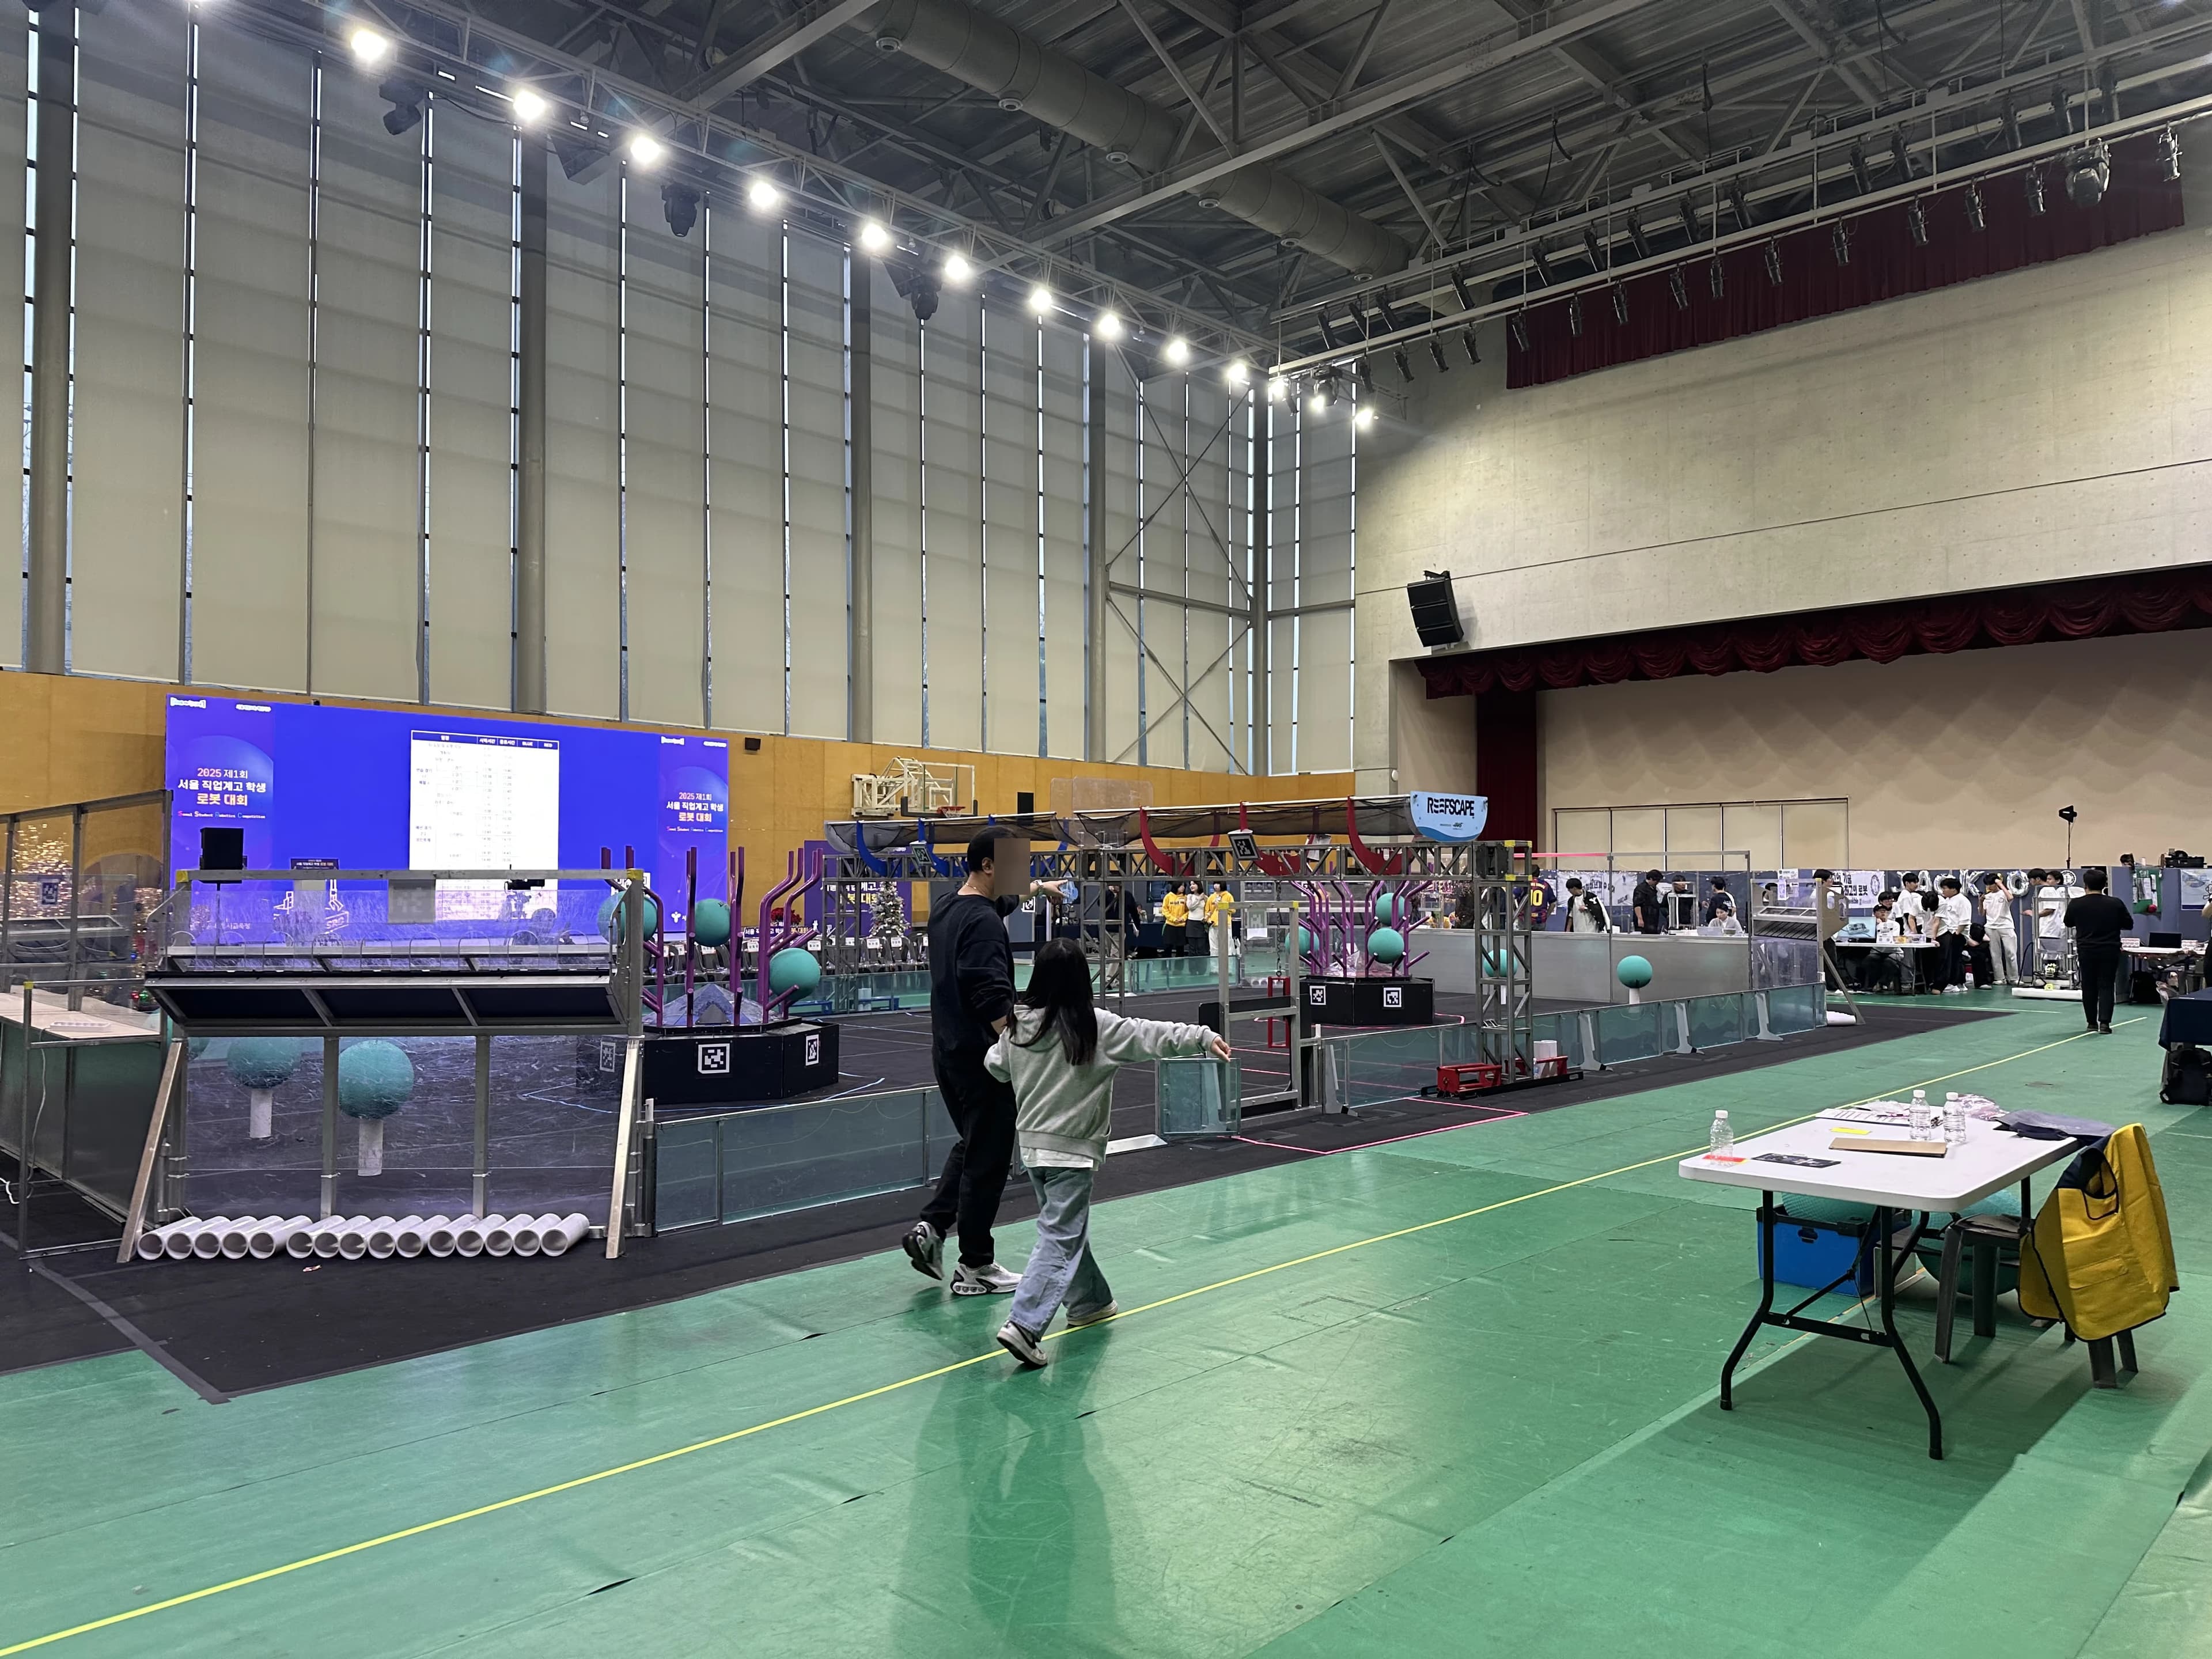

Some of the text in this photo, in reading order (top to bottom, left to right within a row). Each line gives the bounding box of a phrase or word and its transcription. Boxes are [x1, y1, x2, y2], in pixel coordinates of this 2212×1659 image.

[198, 768, 248, 779] 2025 제1회
[178, 779, 266, 793] 서울 직업계고 학생
[197, 793, 248, 806] 로봇 대회
[666, 801, 724, 812] 서울 직업계고 학생
[1427, 797, 1475, 816] REEFSCAPE
[679, 812, 712, 823] 로봇 대회
[1858, 885, 1868, 896] 로봇
